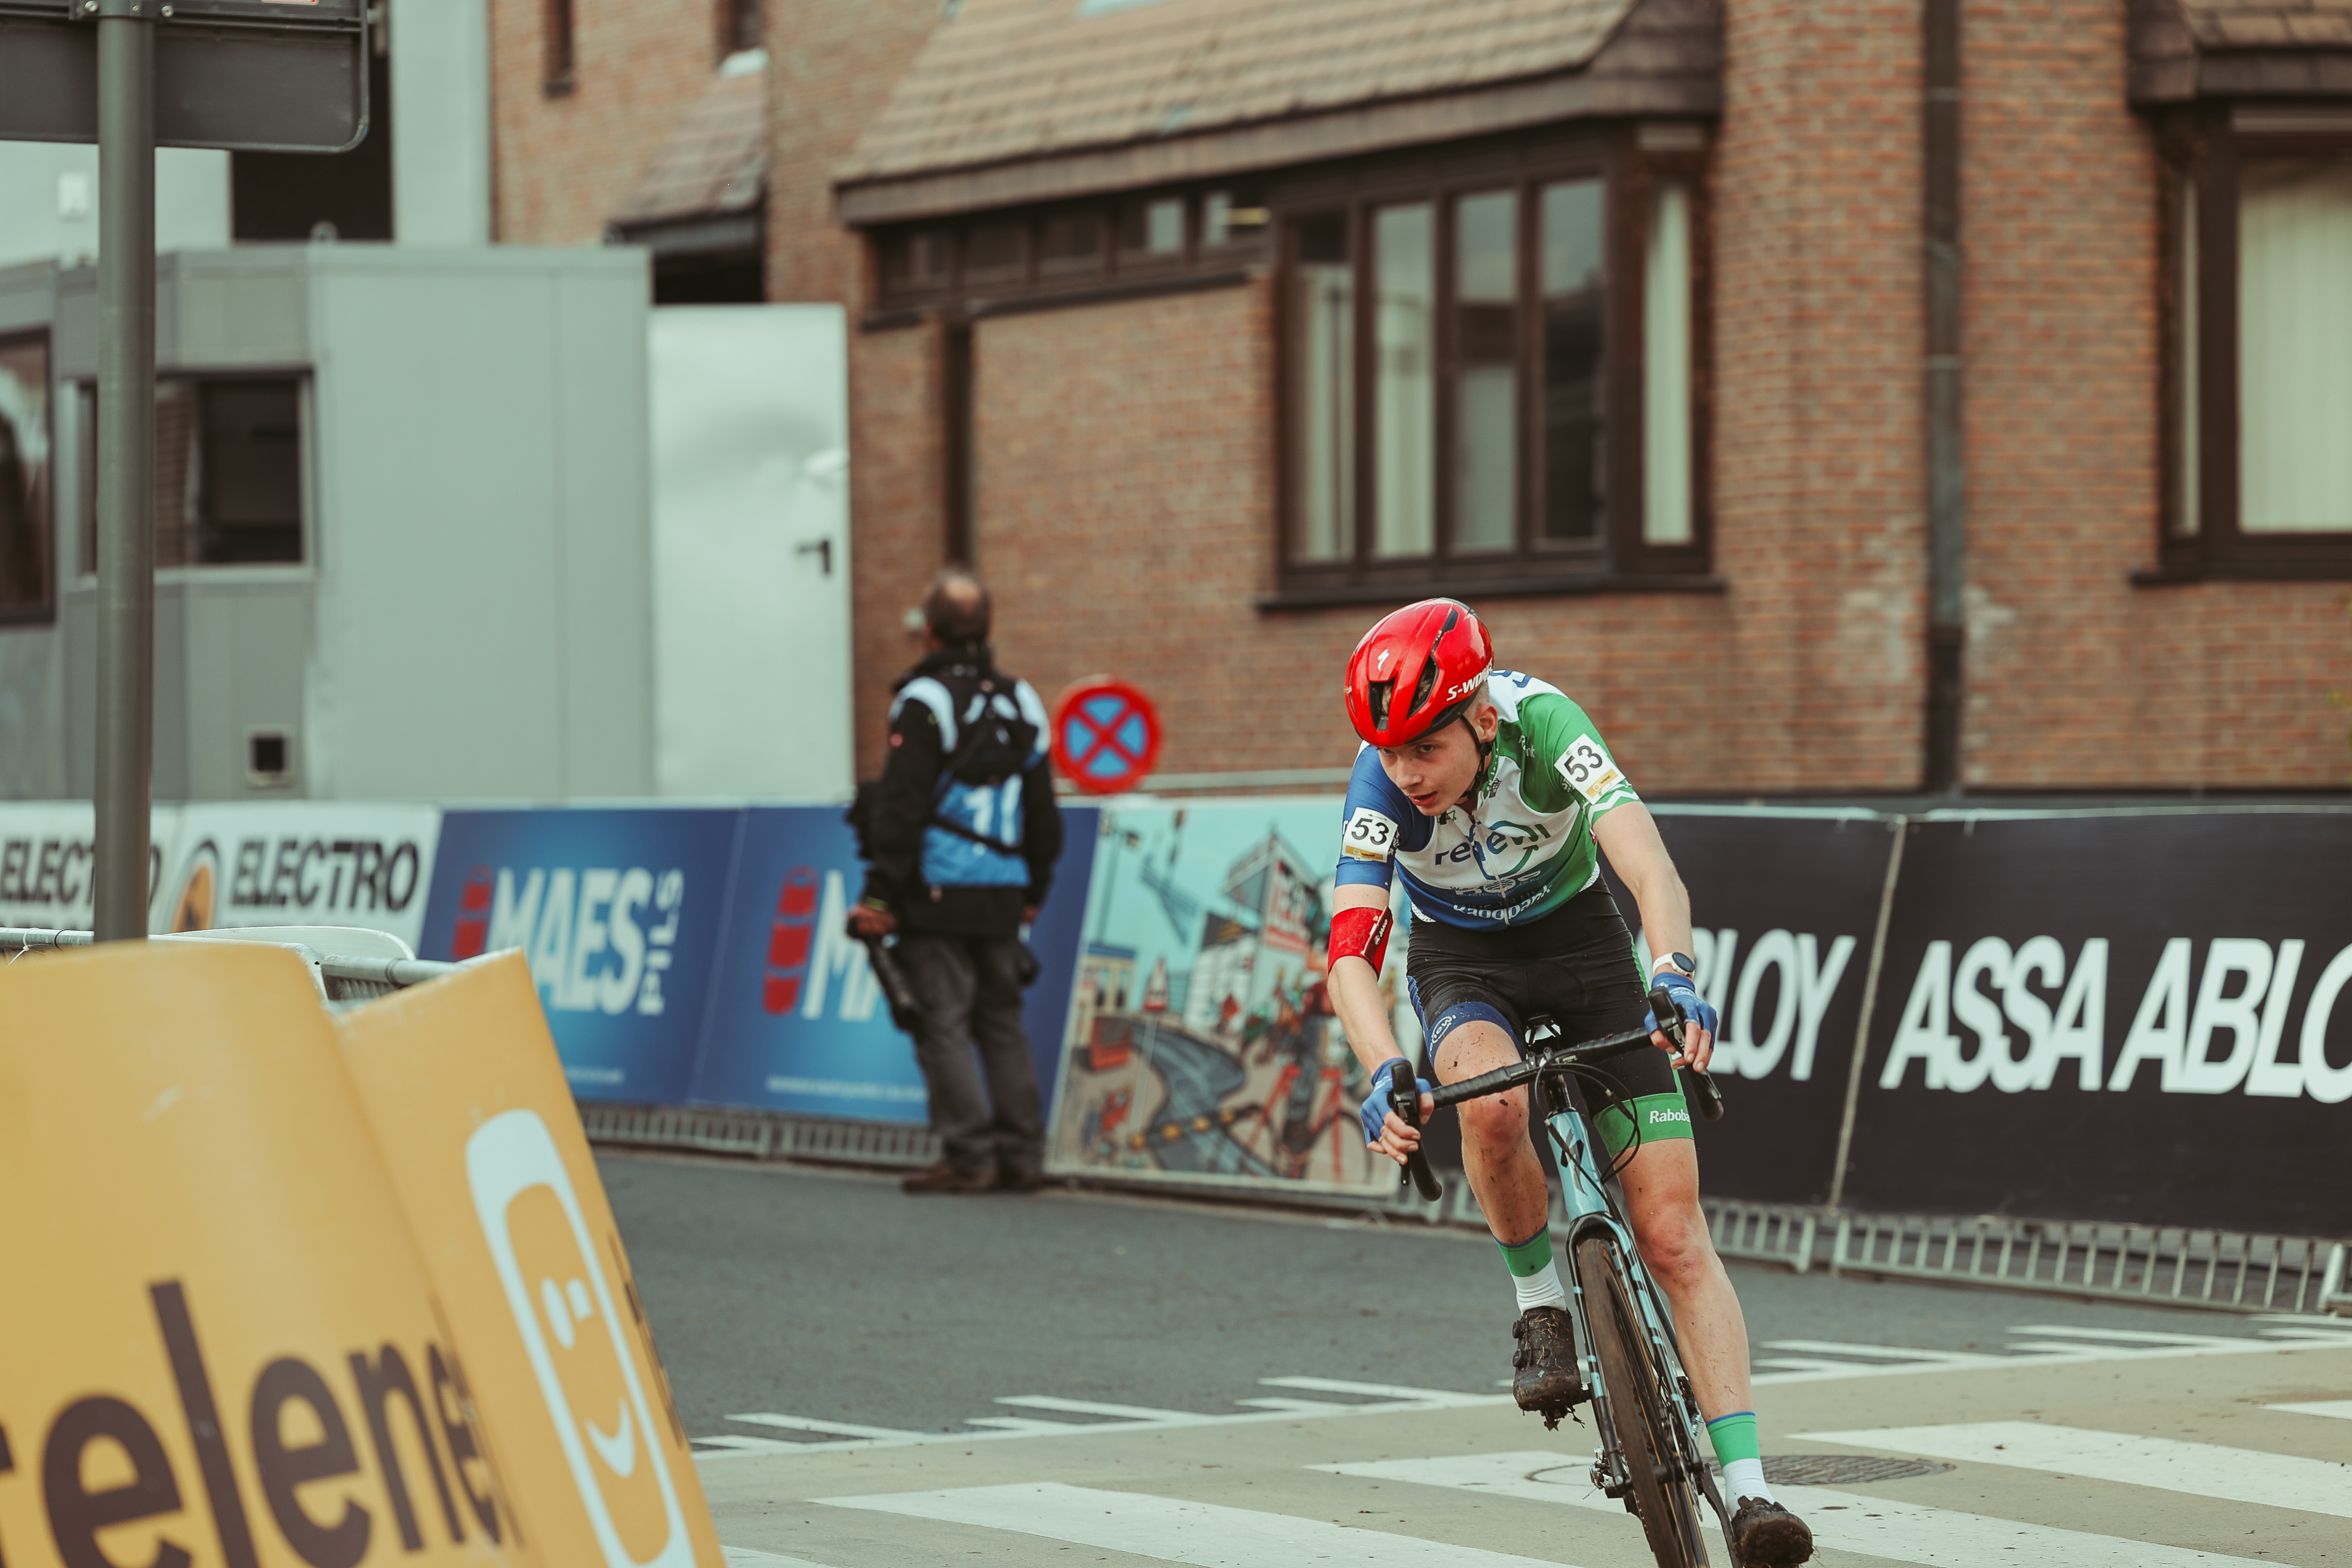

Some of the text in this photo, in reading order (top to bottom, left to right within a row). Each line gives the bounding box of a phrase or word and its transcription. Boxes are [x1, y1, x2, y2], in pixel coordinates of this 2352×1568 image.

[1563, 745, 1603, 782] 53
[1351, 818, 1389, 845] 53
[0, 840, 162, 903] ELEC
[231, 840, 420, 912] ELECTRO
[637, 867, 685, 1016] PILS
[1879, 935, 2352, 1104] ASSA ABLO
[0, 1278, 524, 1568] elene
